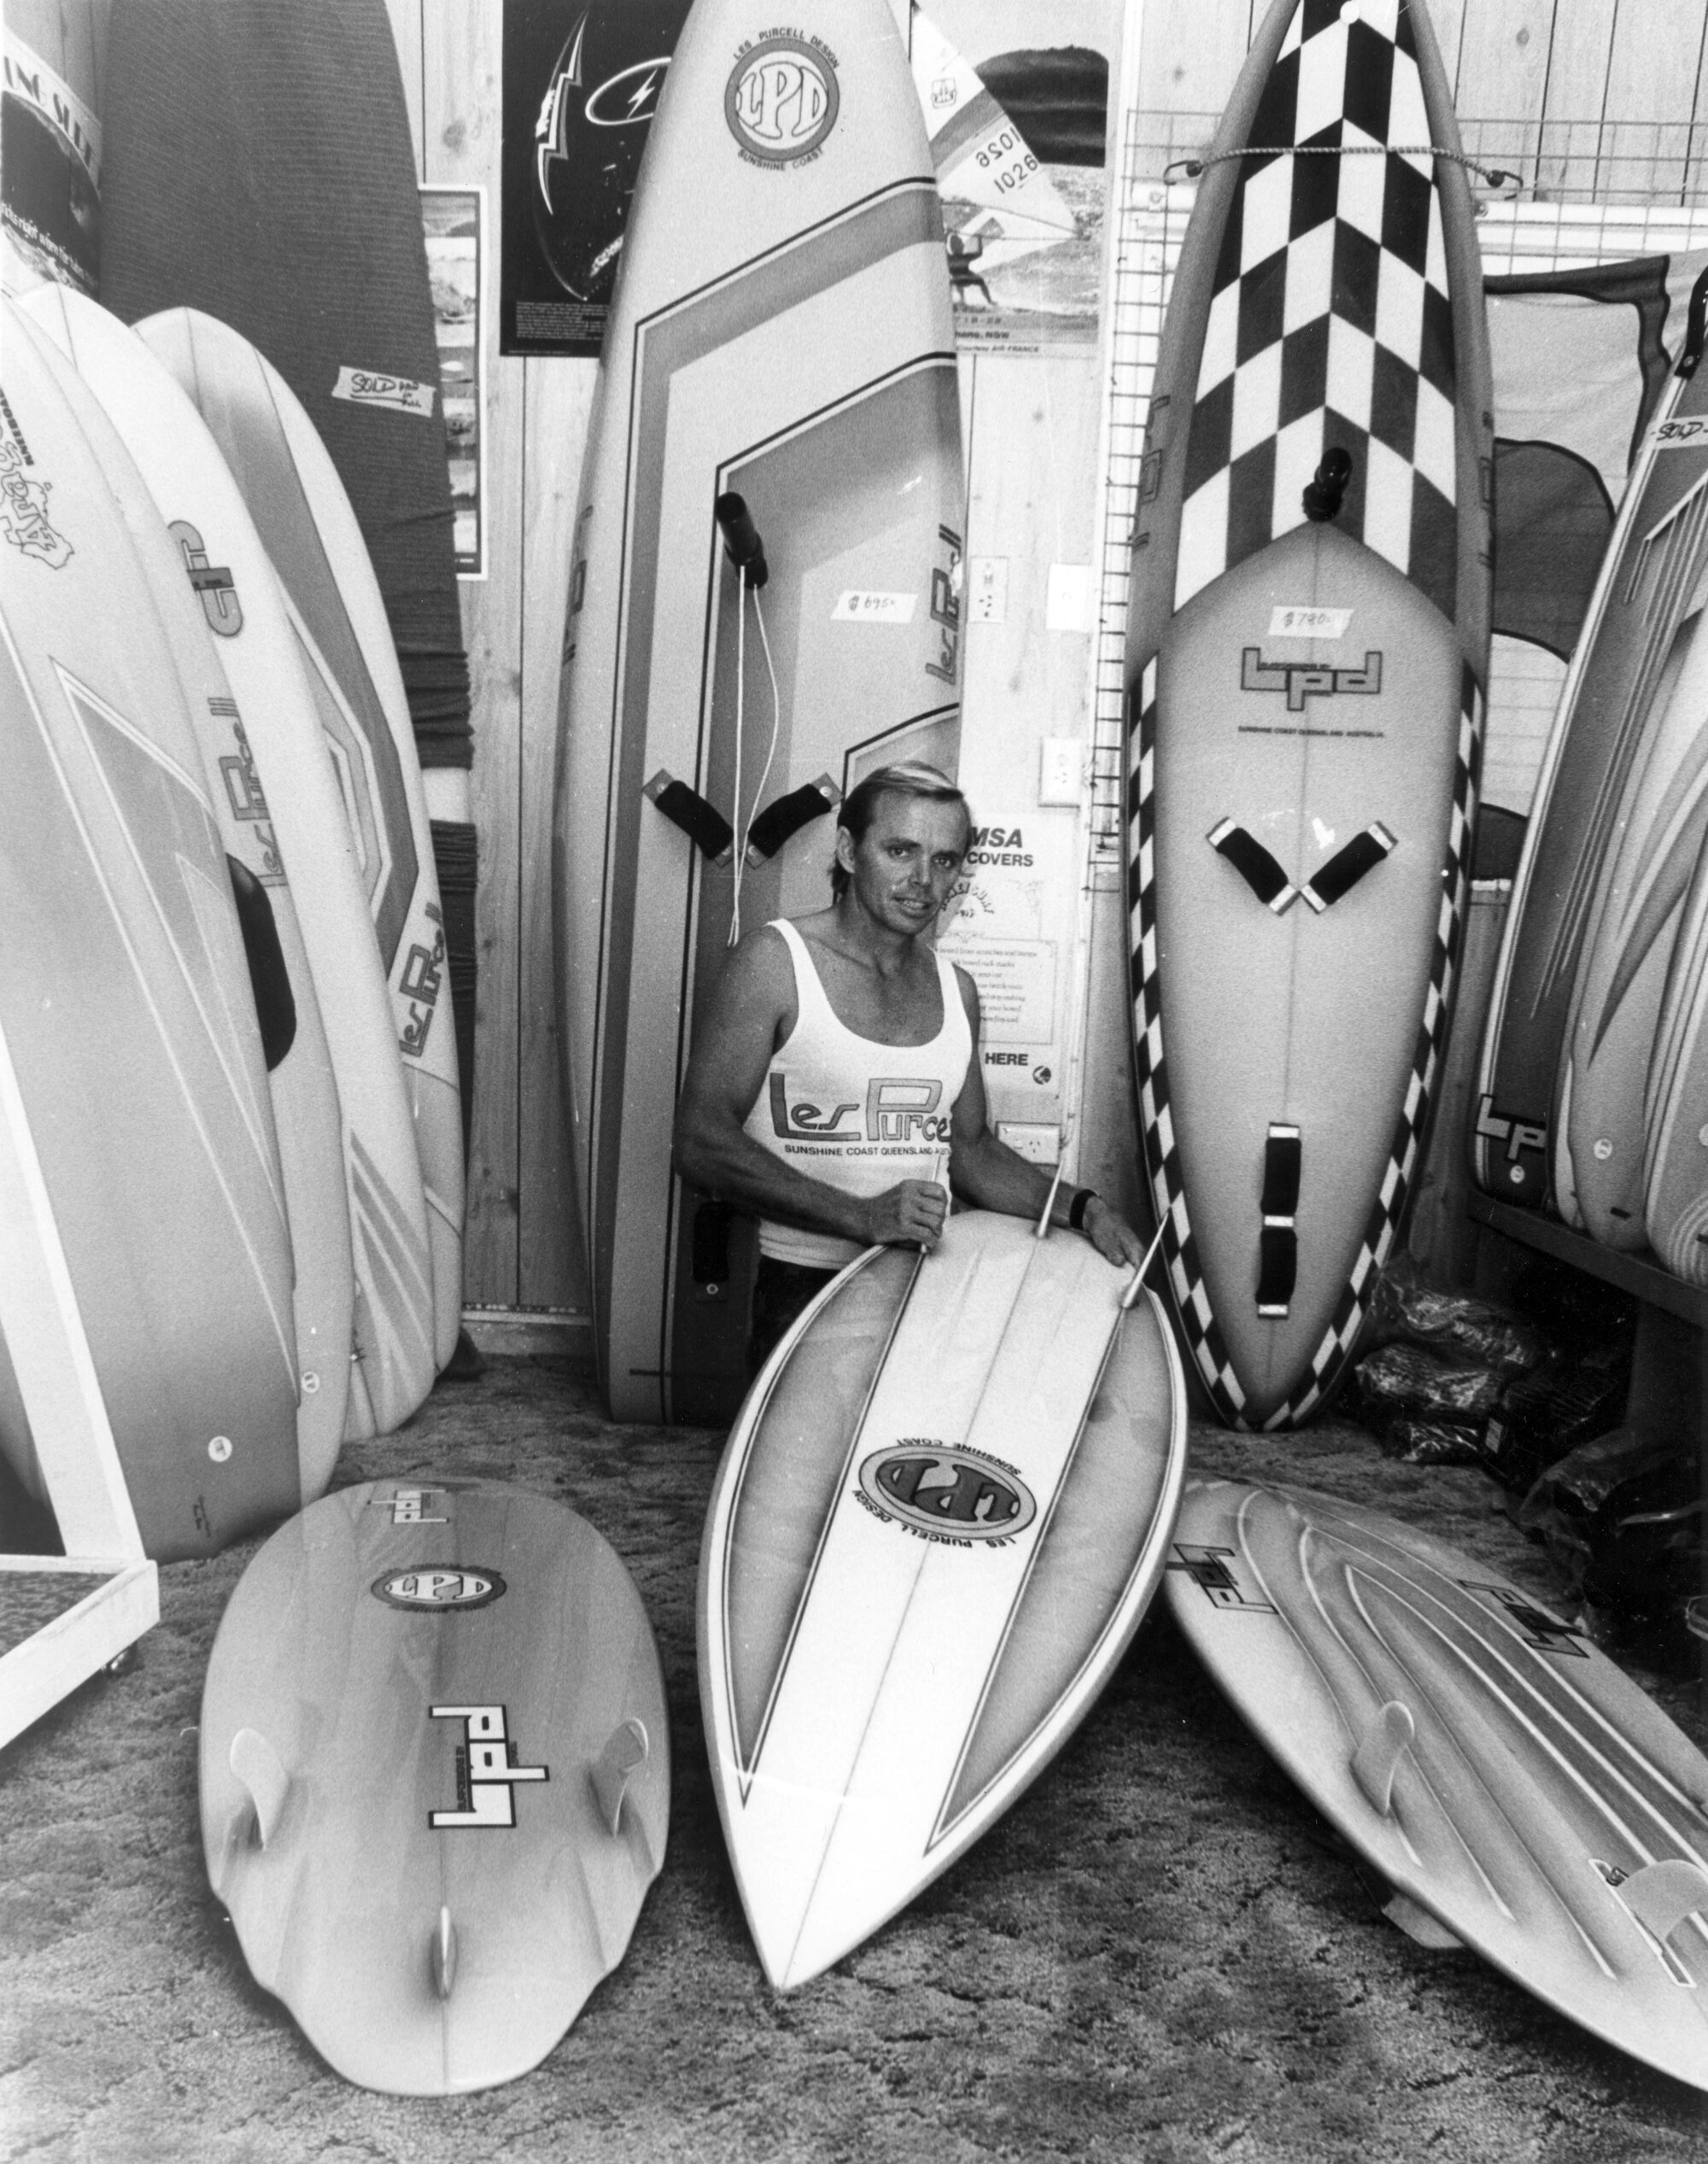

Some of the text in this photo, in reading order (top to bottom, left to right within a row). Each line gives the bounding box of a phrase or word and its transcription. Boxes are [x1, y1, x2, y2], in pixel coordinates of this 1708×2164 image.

[733, 26, 839, 70] LES PURCELL DESIGN
[737, 146, 824, 172] SUNSHINE COAST
[993, 153, 1038, 195] 1026
[351, 372, 397, 394] SOLD
[966, 851, 1034, 868] COVERS
[985, 1051, 1029, 1067] HERE
[769, 1072, 951, 1143] Les Purce
[784, 1144, 844, 1157] SUNSHINE
[846, 1146, 879, 1156] COAST
[880, 1146, 933, 1156] QUEENSLAND
[897, 1437, 1022, 1477] SUNSHINE COAST
[851, 1488, 1016, 1548] LES PURCELL DESIGN
